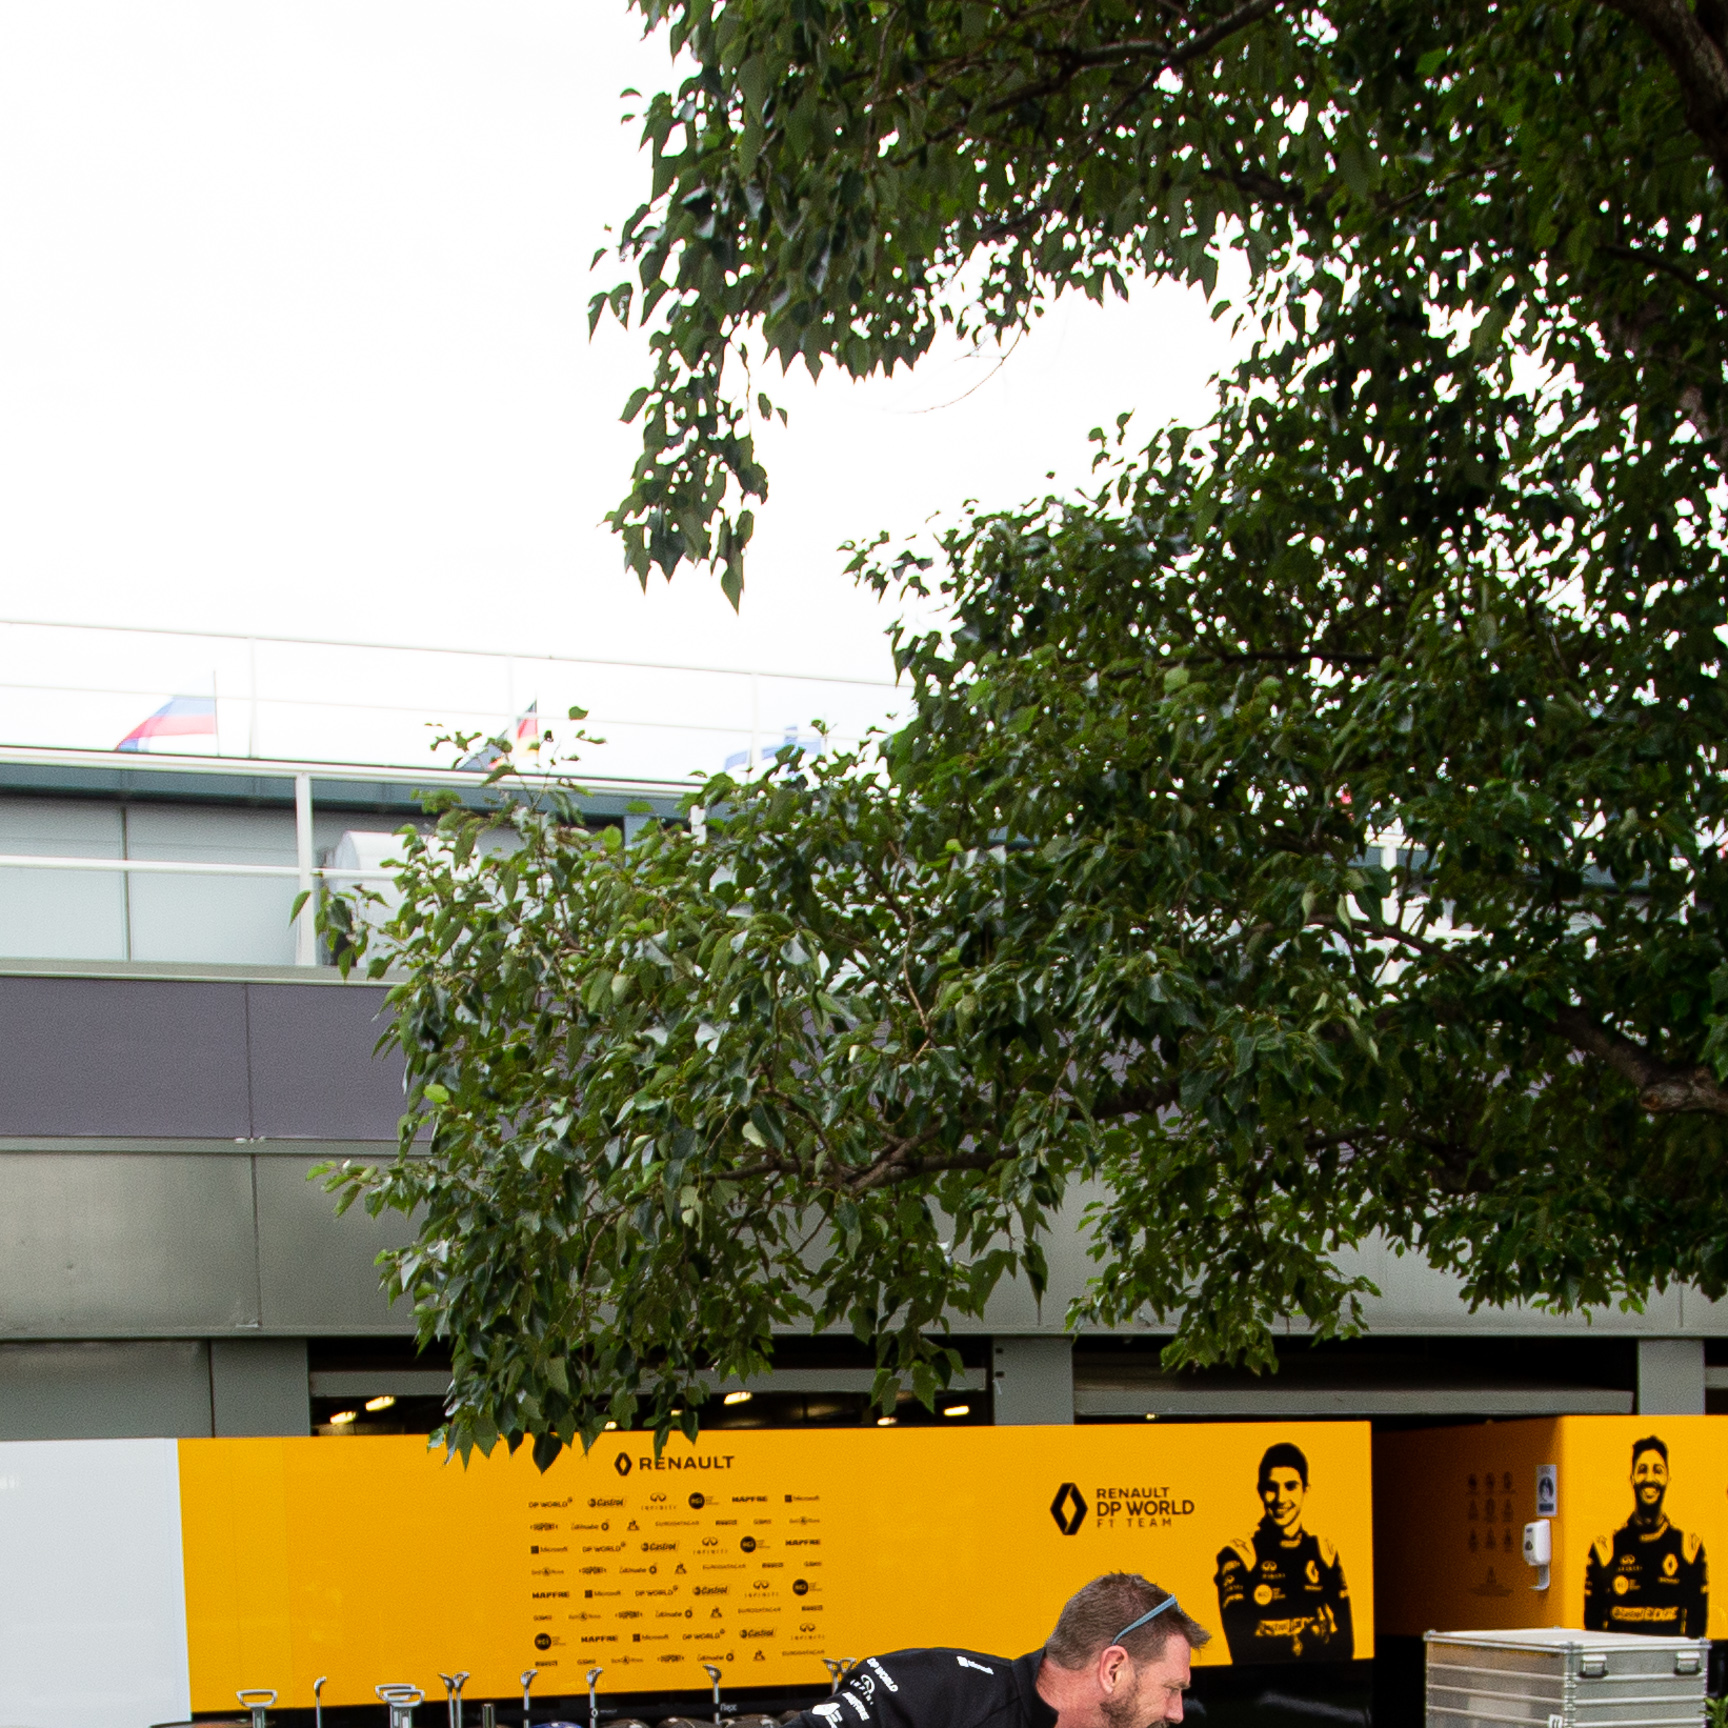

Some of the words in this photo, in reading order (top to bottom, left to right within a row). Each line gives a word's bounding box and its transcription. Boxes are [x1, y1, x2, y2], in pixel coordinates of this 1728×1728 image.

[639, 1455, 735, 1470] RENAULT
[1096, 1487, 1170, 1499] RENAULT
[1097, 1501, 1122, 1516] DP
[1126, 1499, 1195, 1515] WORLD
[1097, 1519, 1114, 1528] F1
[1126, 1518, 1172, 1527] TEAM
[874, 1666, 899, 1692] WORLD
